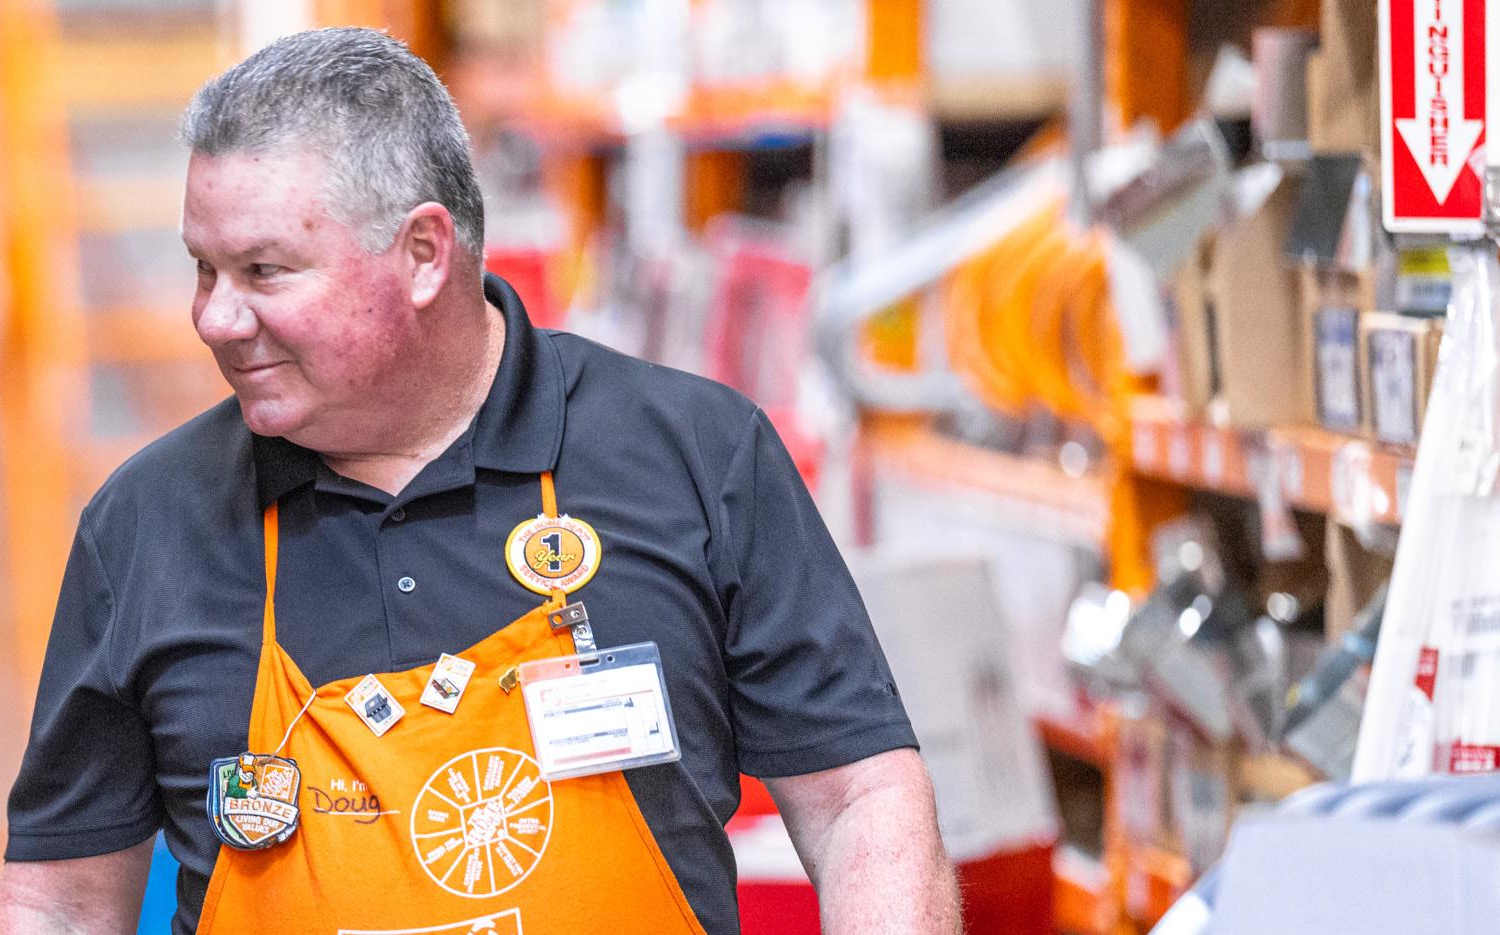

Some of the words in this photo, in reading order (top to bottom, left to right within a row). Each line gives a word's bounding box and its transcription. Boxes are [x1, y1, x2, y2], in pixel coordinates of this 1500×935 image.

[533, 549, 576, 570] Year
[541, 531, 562, 573] 1
[561, 564, 589, 587] AWARD
[229, 799, 293, 819] BRONZE
[307, 786, 381, 824] Doug
